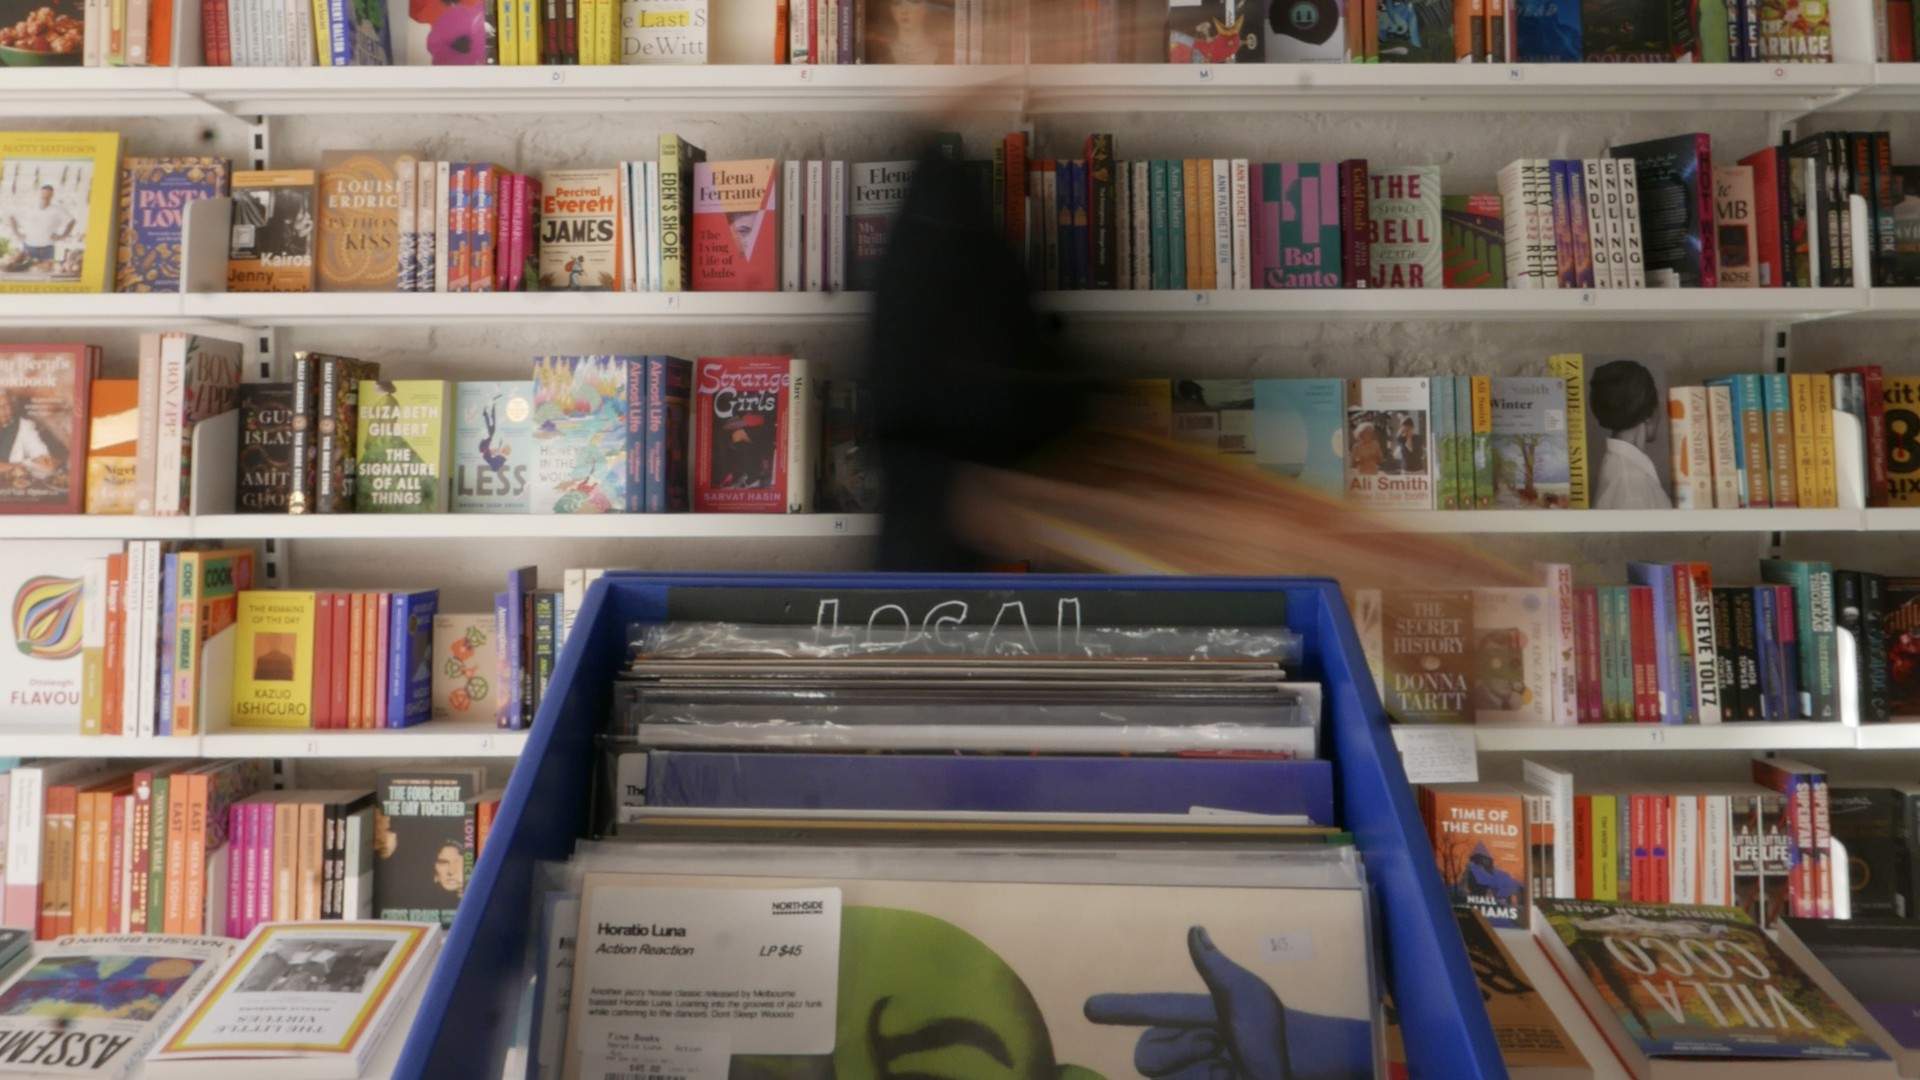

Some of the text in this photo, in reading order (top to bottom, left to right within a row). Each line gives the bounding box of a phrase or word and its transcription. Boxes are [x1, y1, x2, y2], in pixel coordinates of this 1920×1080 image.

[639, 9, 689, 28] Last
[624, 36, 705, 56] DeWitt
[1760, 36, 1829, 55] ARRIAGE
[711, 169, 755, 186] Elena
[1236, 163, 1244, 182] ANN
[337, 180, 400, 193] LOUIS
[555, 186, 601, 199] Percival
[699, 186, 766, 201] Ferrante
[1370, 174, 1421, 199] THE
[328, 195, 401, 208] ERDRIC
[545, 196, 614, 215] Everett
[662, 173, 678, 260] EDEN'S SHORE
[1218, 175, 1229, 265] ANN PATCHETT RUN
[1521, 165, 1543, 278] KILEY REID
[1536, 165, 1558, 278] KILEY REID
[1588, 163, 1607, 266] ENDLING
[1604, 163, 1624, 266] ENDLING
[1622, 163, 1642, 266] ENDLING
[543, 219, 614, 243] JAMES
[1367, 218, 1430, 244] BELL
[345, 233, 393, 251] KISS
[261, 253, 312, 267] Kairos
[1285, 247, 1321, 265] Bel
[229, 271, 274, 284] Jenny
[1267, 268, 1338, 288] Canto
[1372, 264, 1424, 288] JAR
[628, 361, 643, 408] Almost
[649, 361, 663, 408] Almost
[699, 364, 790, 395] Strange
[714, 387, 776, 418] Girls
[1491, 399, 1533, 411] Winter
[360, 405, 440, 419] ELIZABETH
[629, 408, 643, 433] Life
[649, 408, 663, 433] Life
[370, 422, 428, 437] GILBERT
[1565, 360, 1584, 502] ZADIE SMITH
[386, 449, 411, 462] THE
[359, 463, 436, 476] SIGNATURE
[372, 477, 421, 490] OF ALL
[458, 464, 528, 496] LESS
[1350, 476, 1429, 491] Ali Smith
[371, 491, 422, 505] THINGS
[181, 562, 192, 596] COOK
[248, 604, 305, 614] THE REMAINS
[1413, 600, 1445, 618] THE
[1820, 571, 1833, 632] CHRISTOS
[252, 616, 301, 625] OF THE DAY
[816, 597, 1112, 656] LOCAL
[1395, 619, 1465, 636] SECRET
[1393, 636, 1466, 654] HISTORY
[1694, 605, 1717, 708] STEVE TOLTZ
[1747, 659, 1757, 685] AMOR
[1394, 672, 1468, 691] DONNA
[10, 690, 80, 705] FLAVOU
[254, 689, 292, 699] KAZUO
[1393, 693, 1468, 712] TARTT
[236, 702, 308, 716] ISHIGURO
[388, 786, 406, 801] THE
[432, 786, 461, 801] SPENT
[172, 801, 183, 832] EAST
[191, 802, 202, 833] EAST
[383, 801, 465, 817] THE DAY TOGETHER
[1450, 808, 1509, 822] TIME OF
[464, 819, 475, 849] LOVE
[1442, 820, 1519, 837] THE CHILD
[1734, 847, 1759, 860] LIFE
[1762, 847, 1788, 860] LIFE
[772, 901, 823, 910] NORTHSIDE
[1467, 895, 1496, 907] NIALL
[597, 922, 687, 938] Horatio Luna
[76, 936, 225, 949] NATASHA BROWN
[595, 943, 694, 957] Action Reaction
[759, 944, 803, 957] LP $45
[1603, 936, 1770, 980] COCO
[741, 988, 751, 999] by
[753, 989, 796, 998] Melbourne
[659, 1009, 672, 1017] the
[727, 1000, 740, 1008] the
[776, 1000, 786, 1008] of
[1640, 979, 1816, 1029] VILLA
[0, 1030, 133, 1070] ASSEM
